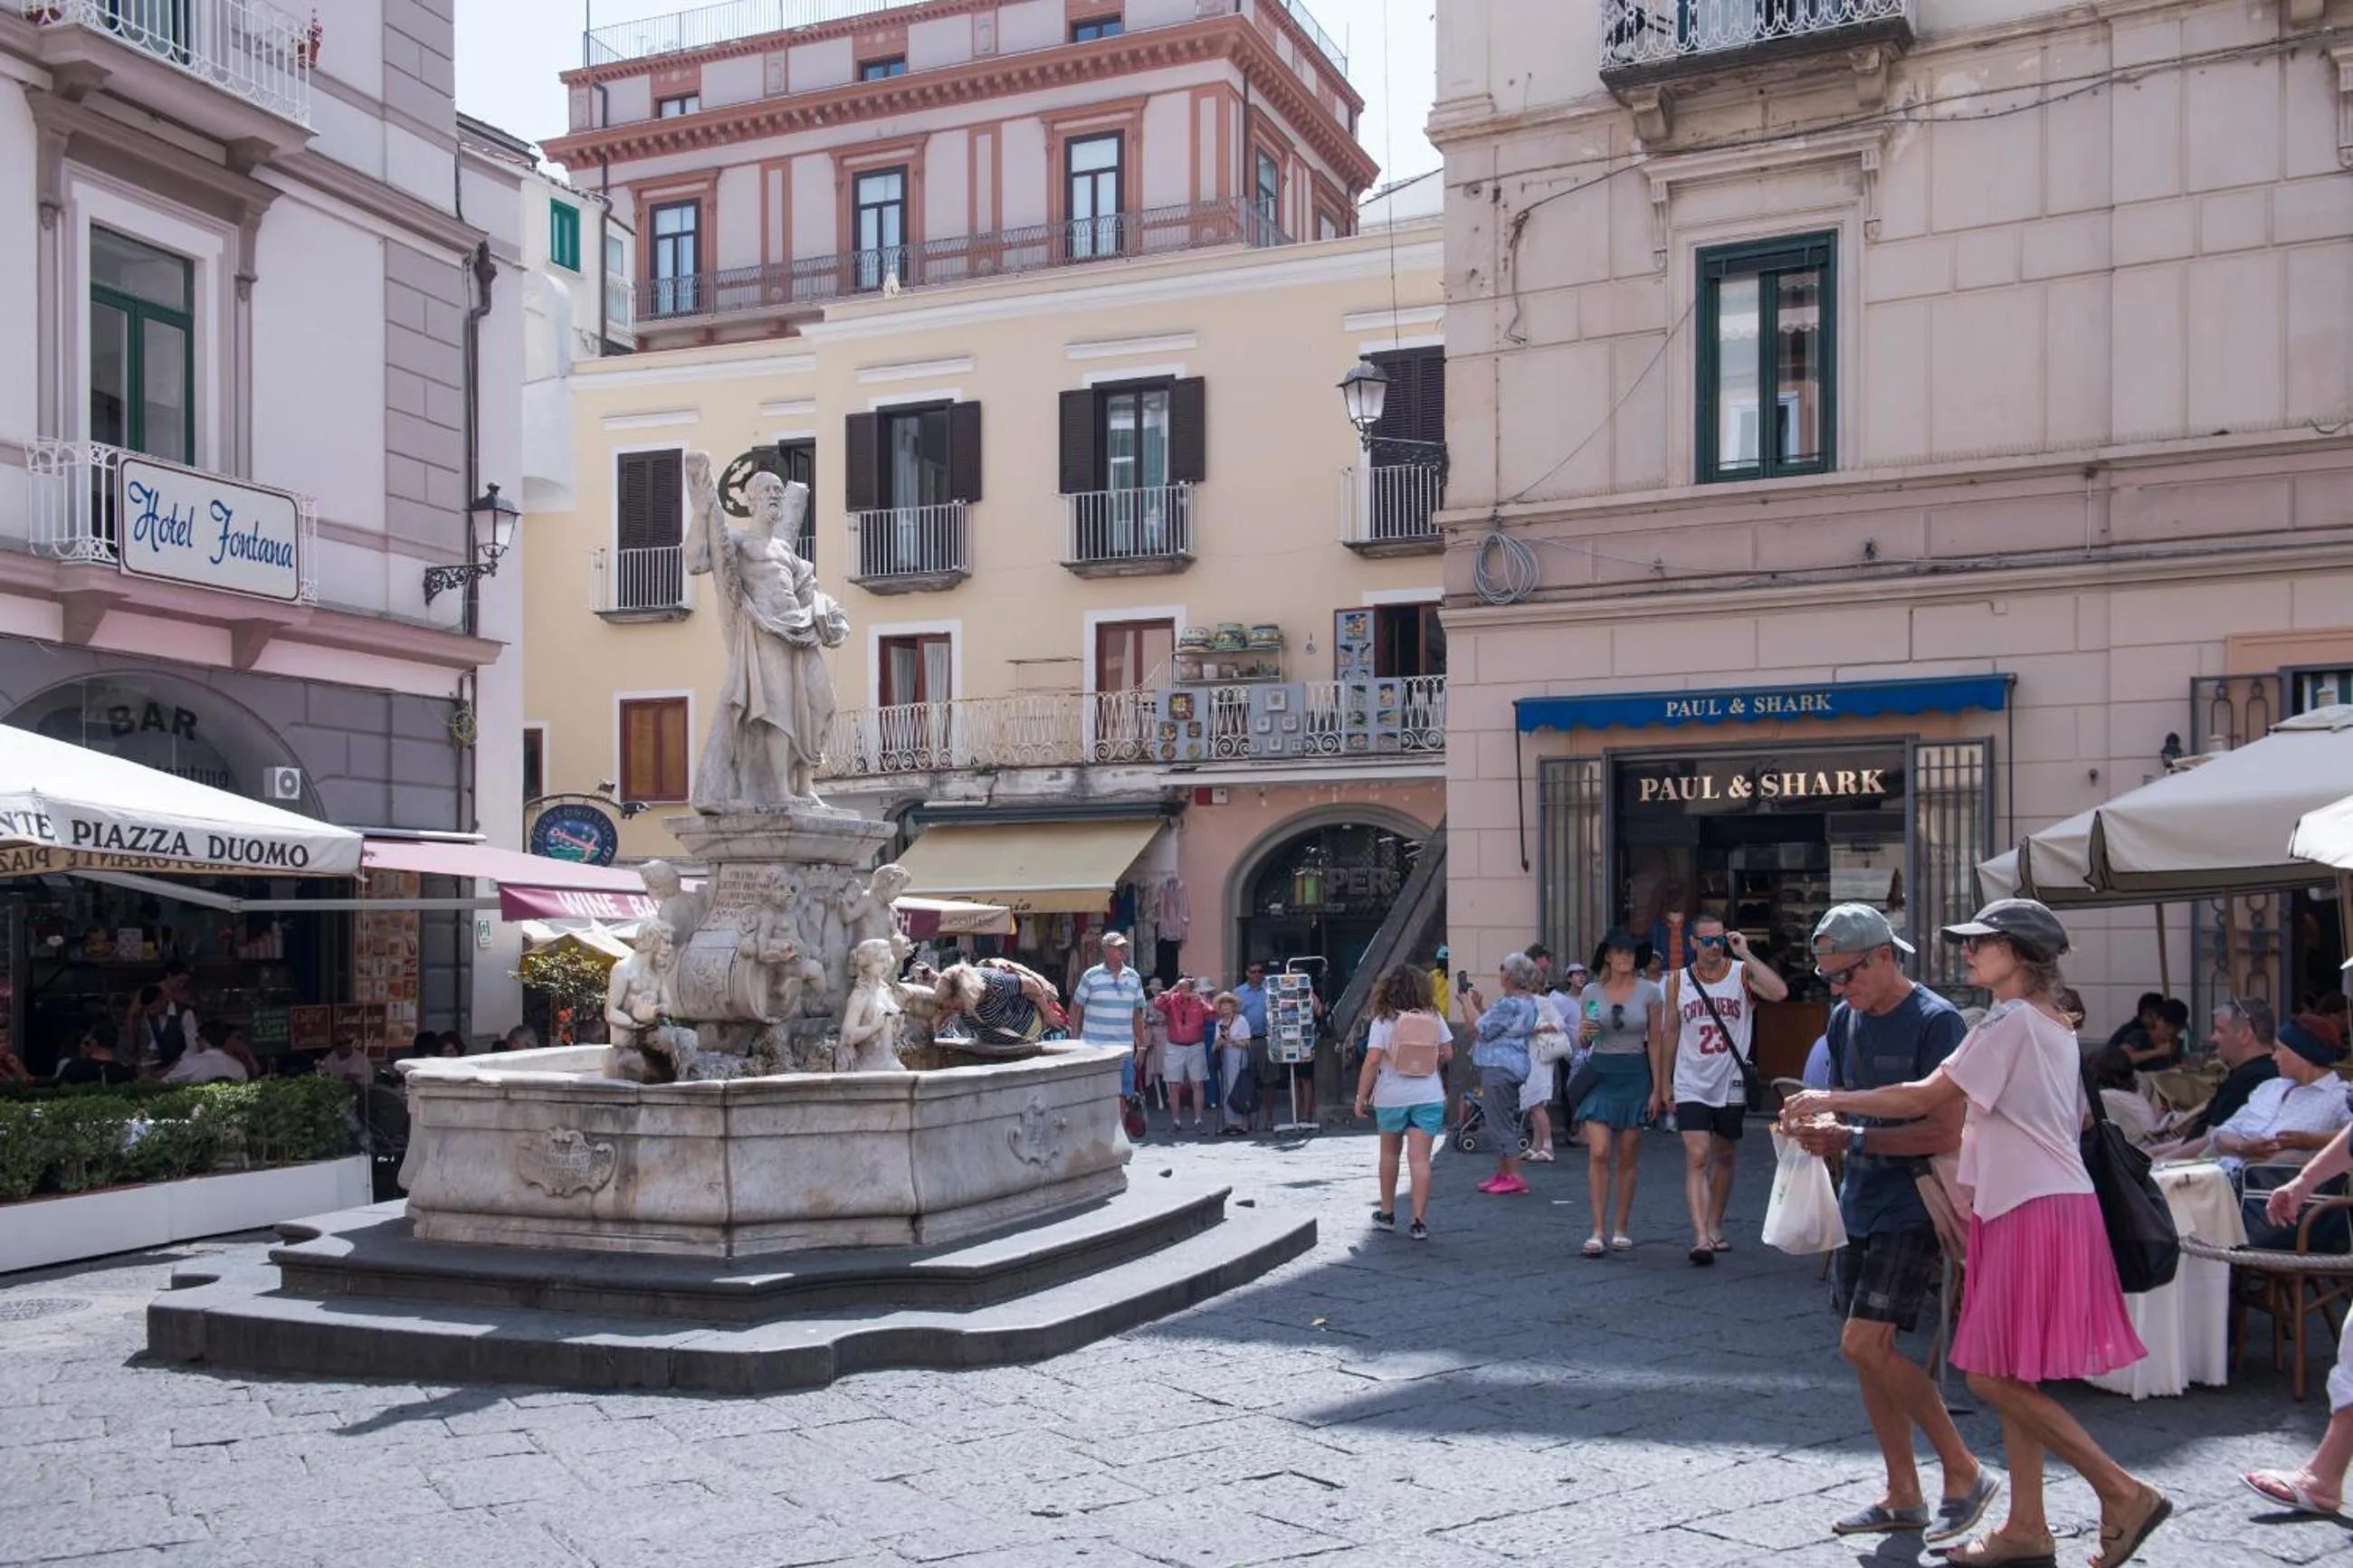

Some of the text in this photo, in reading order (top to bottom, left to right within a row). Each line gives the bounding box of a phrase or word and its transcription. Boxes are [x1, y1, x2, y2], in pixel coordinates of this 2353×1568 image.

[129, 480, 292, 568] Hotel Fontana
[108, 701, 198, 740] BAR
[1666, 693, 1833, 717] PAUL & SHARK
[1639, 769, 1887, 802] PAUL & SHARK
[71, 820, 191, 857] PIAZZA
[208, 835, 310, 868] DUOMO
[556, 890, 623, 917] WINE
